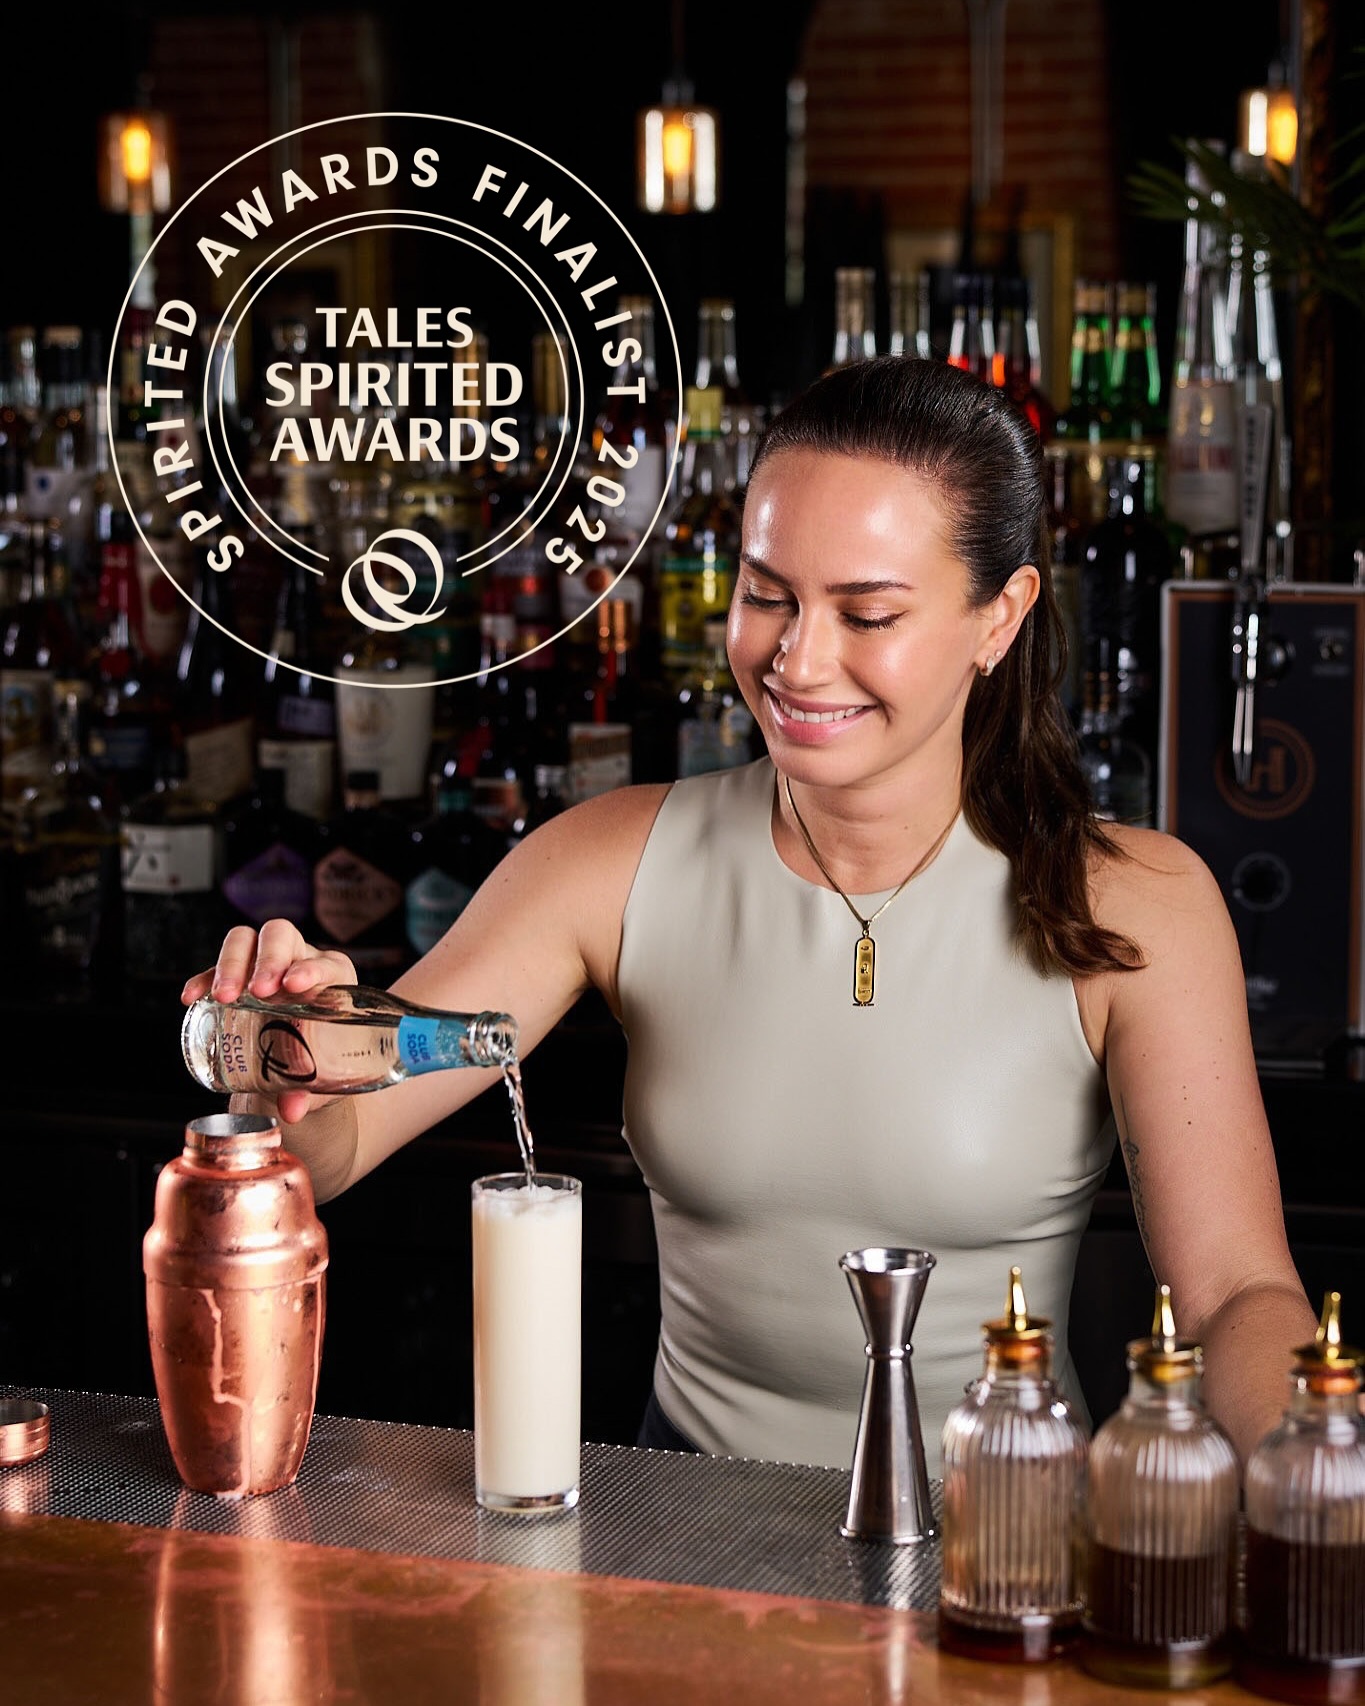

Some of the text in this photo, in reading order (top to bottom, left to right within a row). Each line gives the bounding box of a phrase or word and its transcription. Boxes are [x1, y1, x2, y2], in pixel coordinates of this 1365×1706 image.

[222, 1032, 235, 1074] SODA
[233, 1034, 248, 1073] CLUB
[406, 1032, 420, 1065] SODA
[417, 1033, 431, 1061] CLUB
